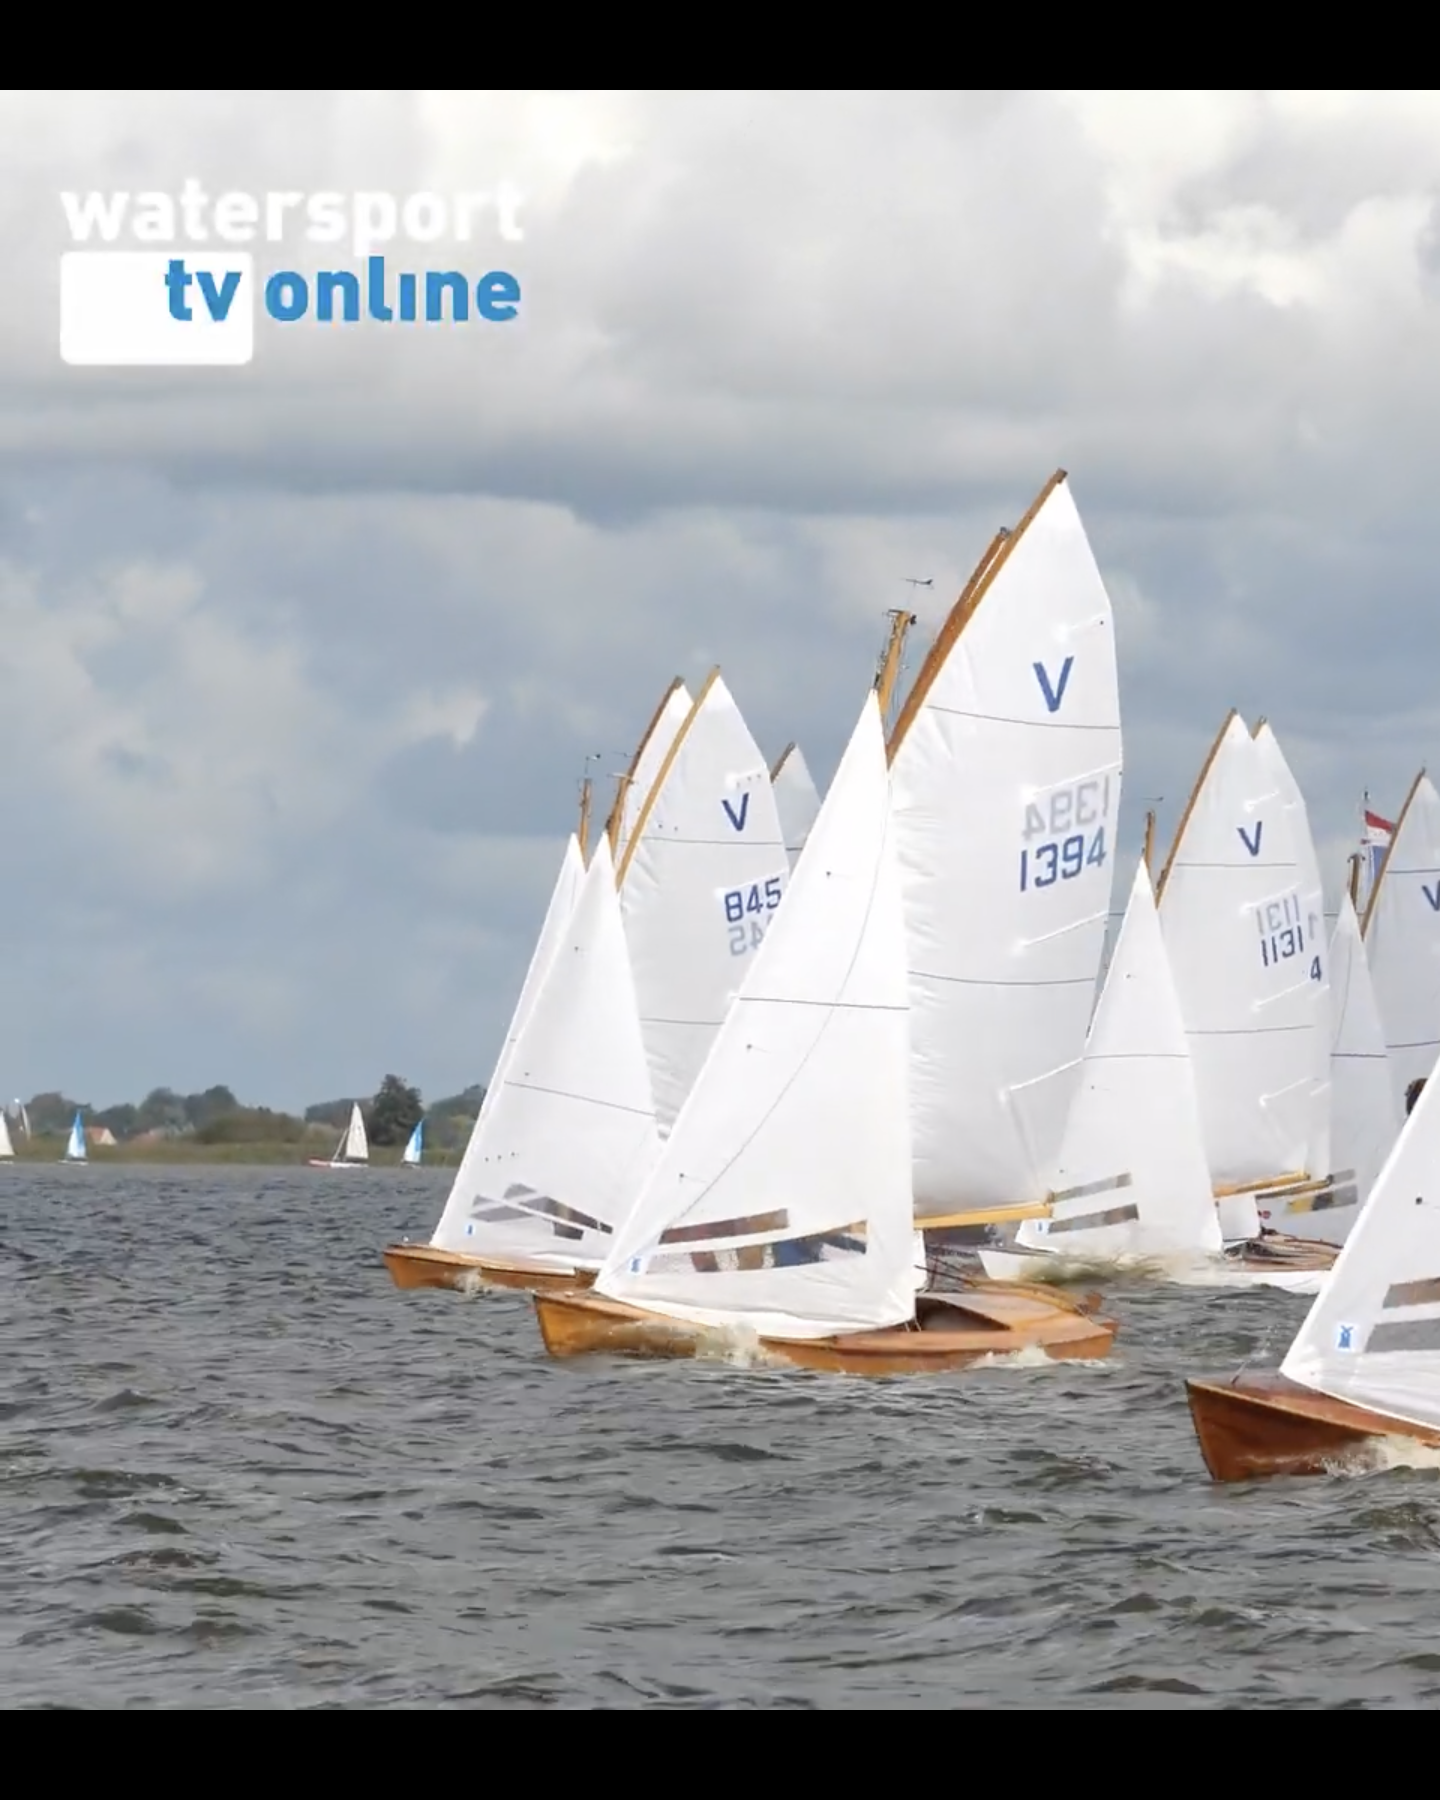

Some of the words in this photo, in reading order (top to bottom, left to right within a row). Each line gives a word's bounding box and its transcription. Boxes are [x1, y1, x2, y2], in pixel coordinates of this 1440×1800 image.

[1033, 656, 1074, 712] V
[722, 793, 749, 831] V
[1019, 826, 1107, 891] 1394
[1237, 821, 1262, 856] V
[725, 877, 782, 923] 845
[1261, 924, 1304, 967] 1131
